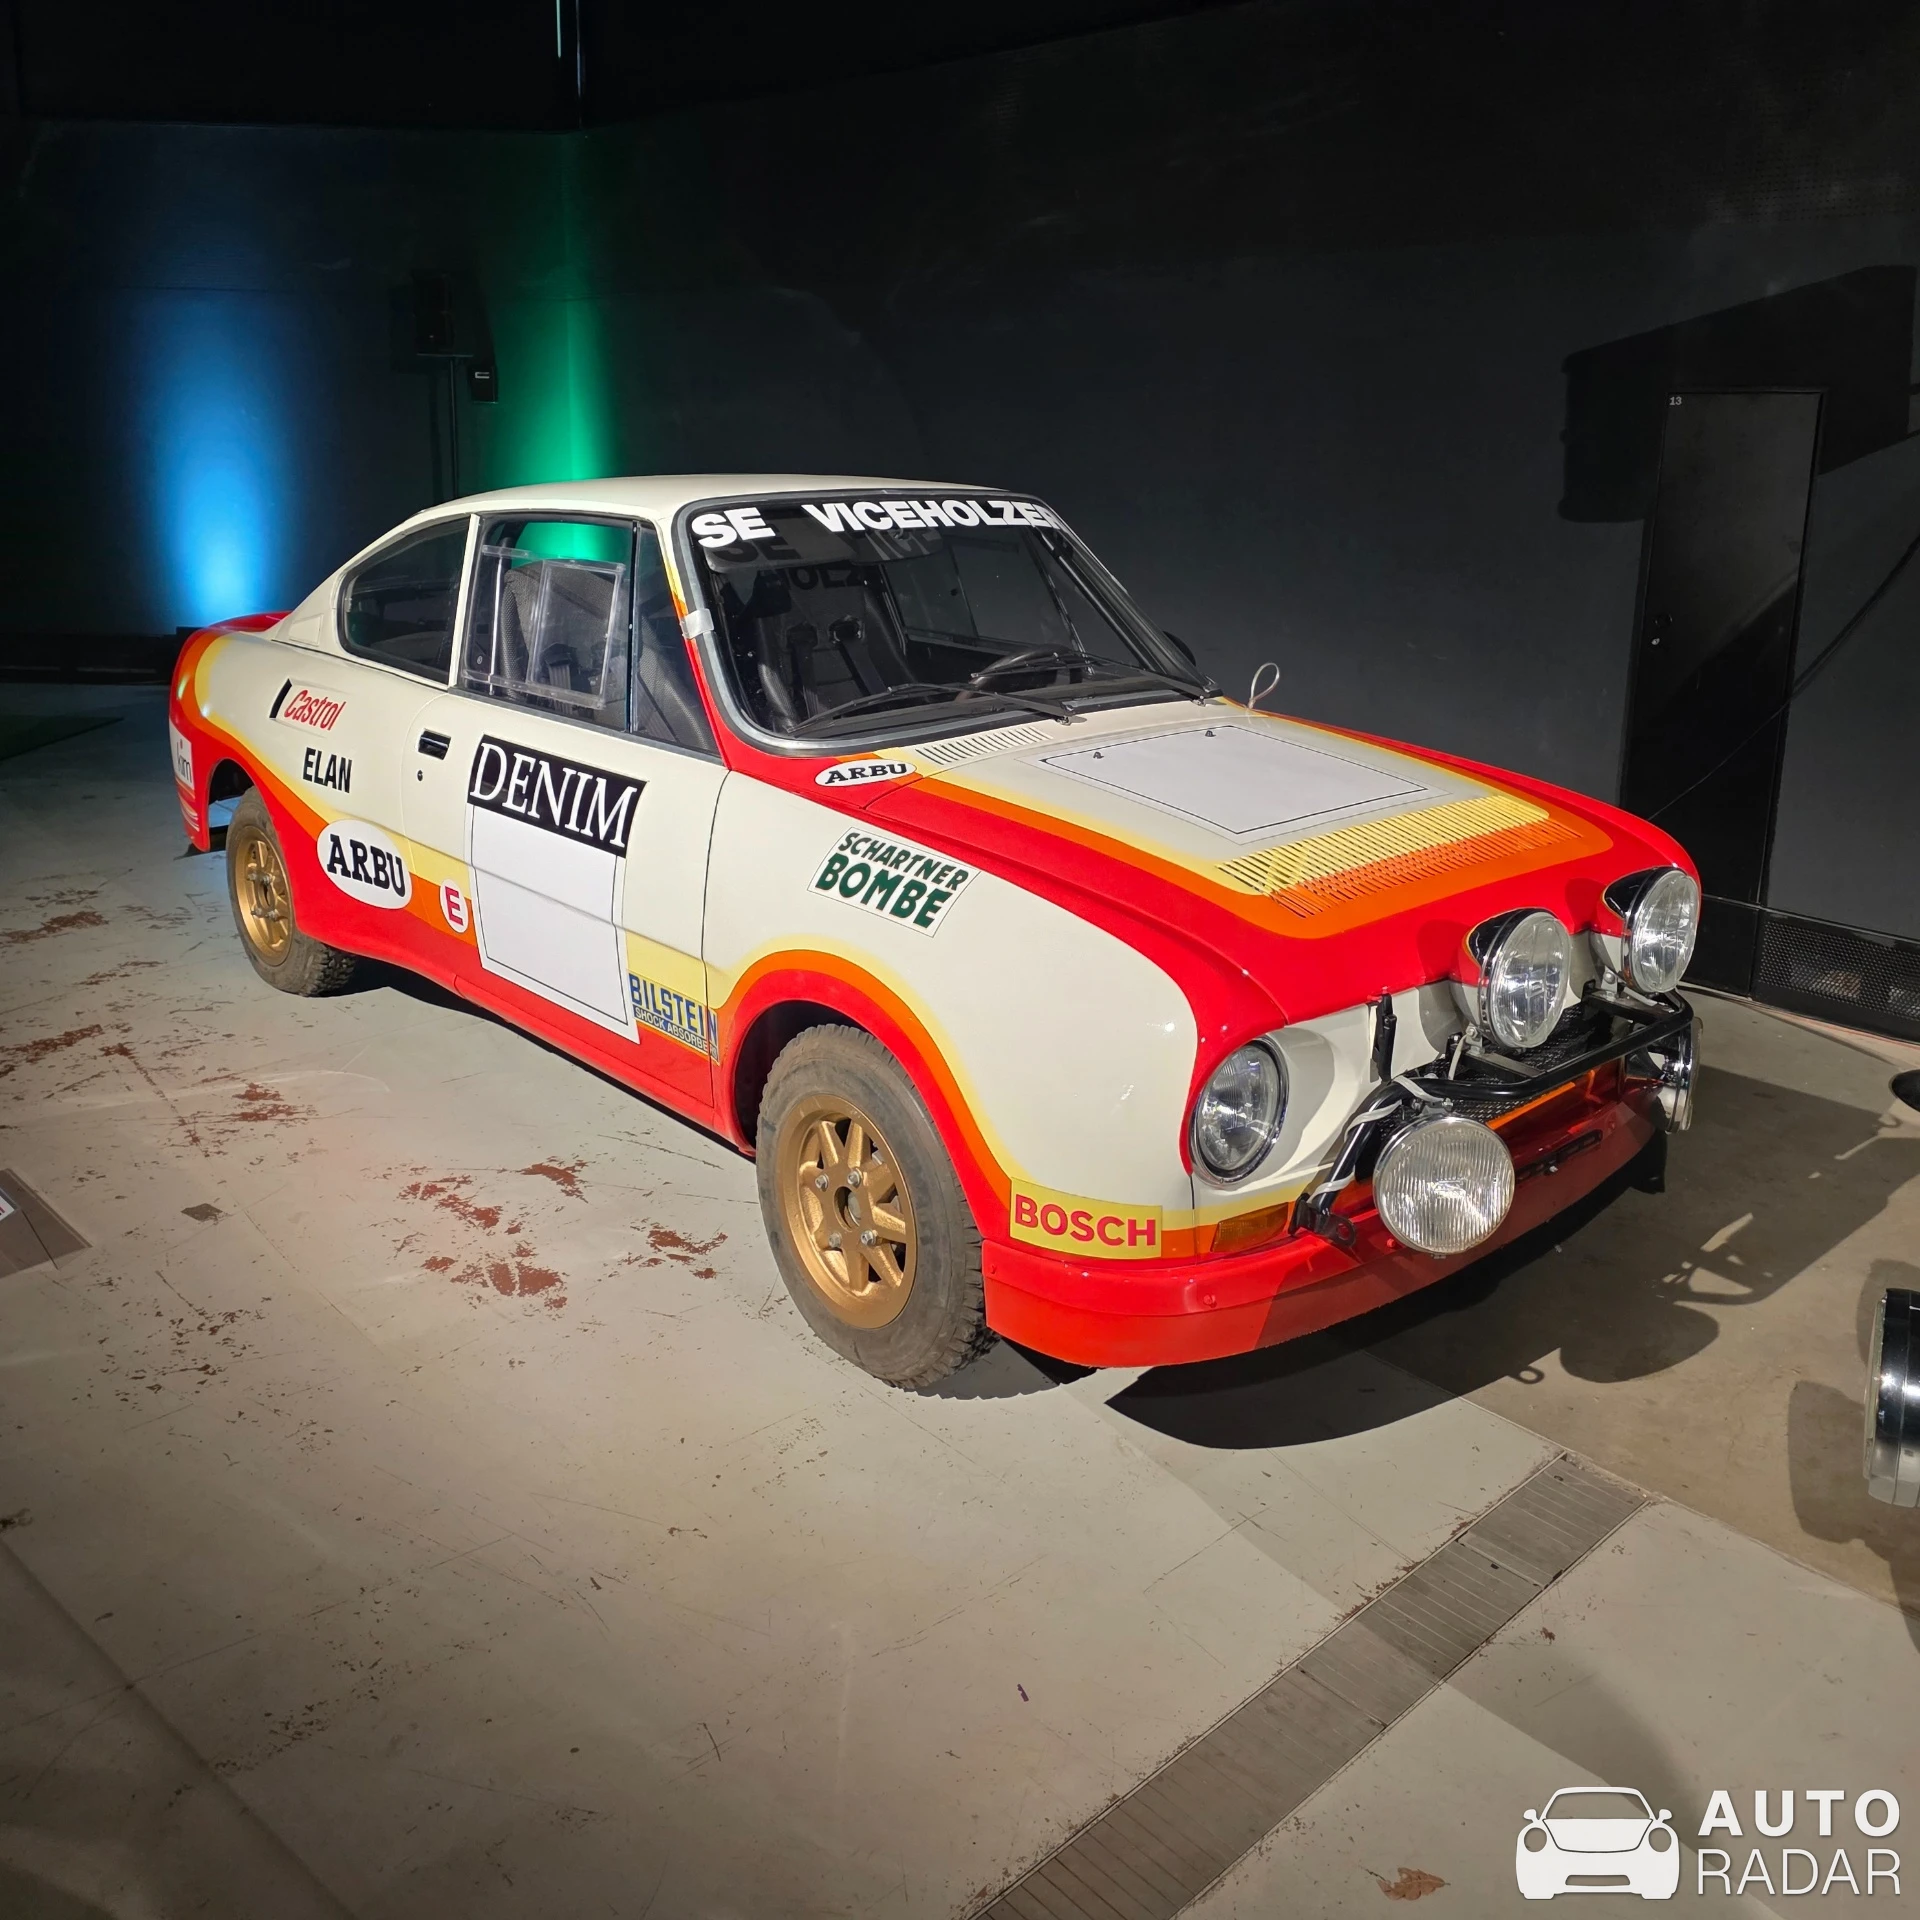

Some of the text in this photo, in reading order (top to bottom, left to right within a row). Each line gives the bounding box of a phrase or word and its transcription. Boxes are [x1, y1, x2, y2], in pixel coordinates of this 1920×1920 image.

[1669, 396, 1683, 406] 13
[691, 501, 1069, 548] SE VICEHOLZER
[283, 689, 347, 731] Castrol
[302, 747, 353, 794] ELAN
[824, 763, 908, 785] ARBU
[469, 741, 638, 848] DENIM
[326, 833, 406, 898] ARBU
[837, 832, 969, 892] SCHARTNER
[444, 885, 464, 926] E
[814, 852, 953, 929] BOMBE
[628, 973, 718, 1047] BILSTEIN
[634, 1006, 666, 1031] SHOCK
[1014, 1193, 1157, 1247] BOSCH
